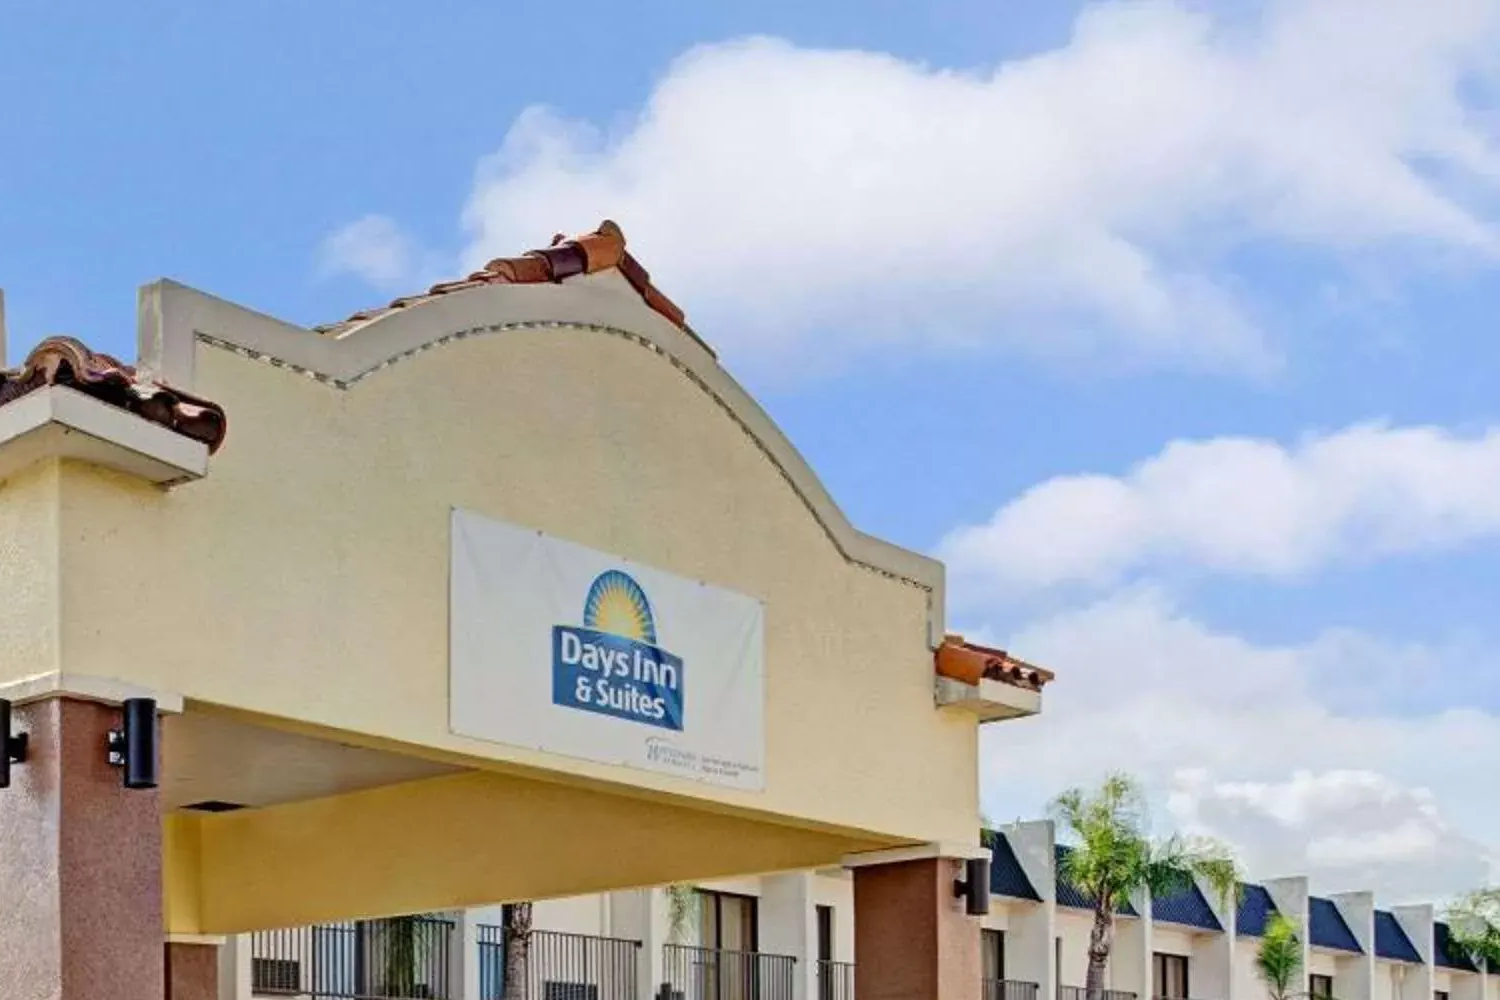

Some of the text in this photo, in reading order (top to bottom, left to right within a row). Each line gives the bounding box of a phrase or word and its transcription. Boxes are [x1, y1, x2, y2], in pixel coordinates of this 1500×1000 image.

[561, 631, 677, 690] Days Inn
[575, 676, 665, 719] & Suites
